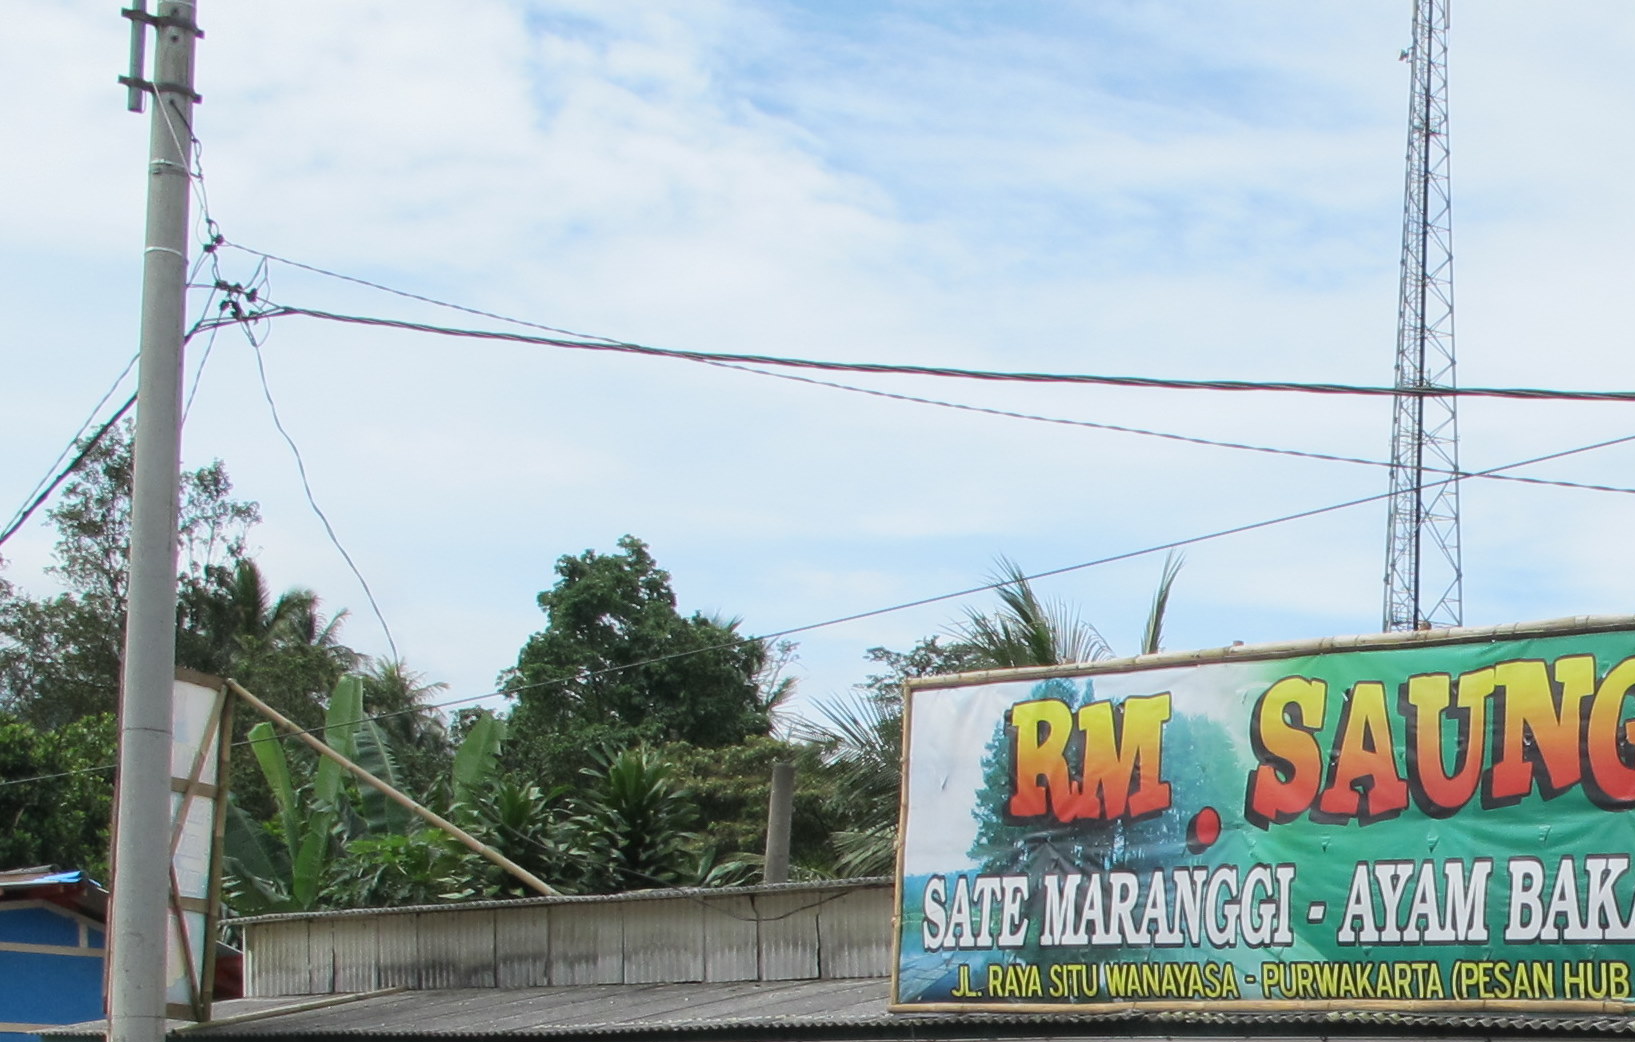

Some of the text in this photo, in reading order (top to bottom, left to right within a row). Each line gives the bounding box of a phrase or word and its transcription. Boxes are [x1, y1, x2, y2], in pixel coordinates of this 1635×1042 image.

[922, 874, 1030, 951] SATE
[1039, 863, 1297, 949] MARANGGI
[1337, 858, 1494, 946] AYAM
[952, 964, 982, 998] JL.
[988, 963, 1043, 998] RAYA
[1048, 962, 1098, 998] SITU
[1104, 961, 1240, 999] WANAYASA
[1261, 961, 1445, 999] PURWAKARTA
[1450, 960, 1553, 1001] (PESAN
[1563, 961, 1630, 1000] HUB
